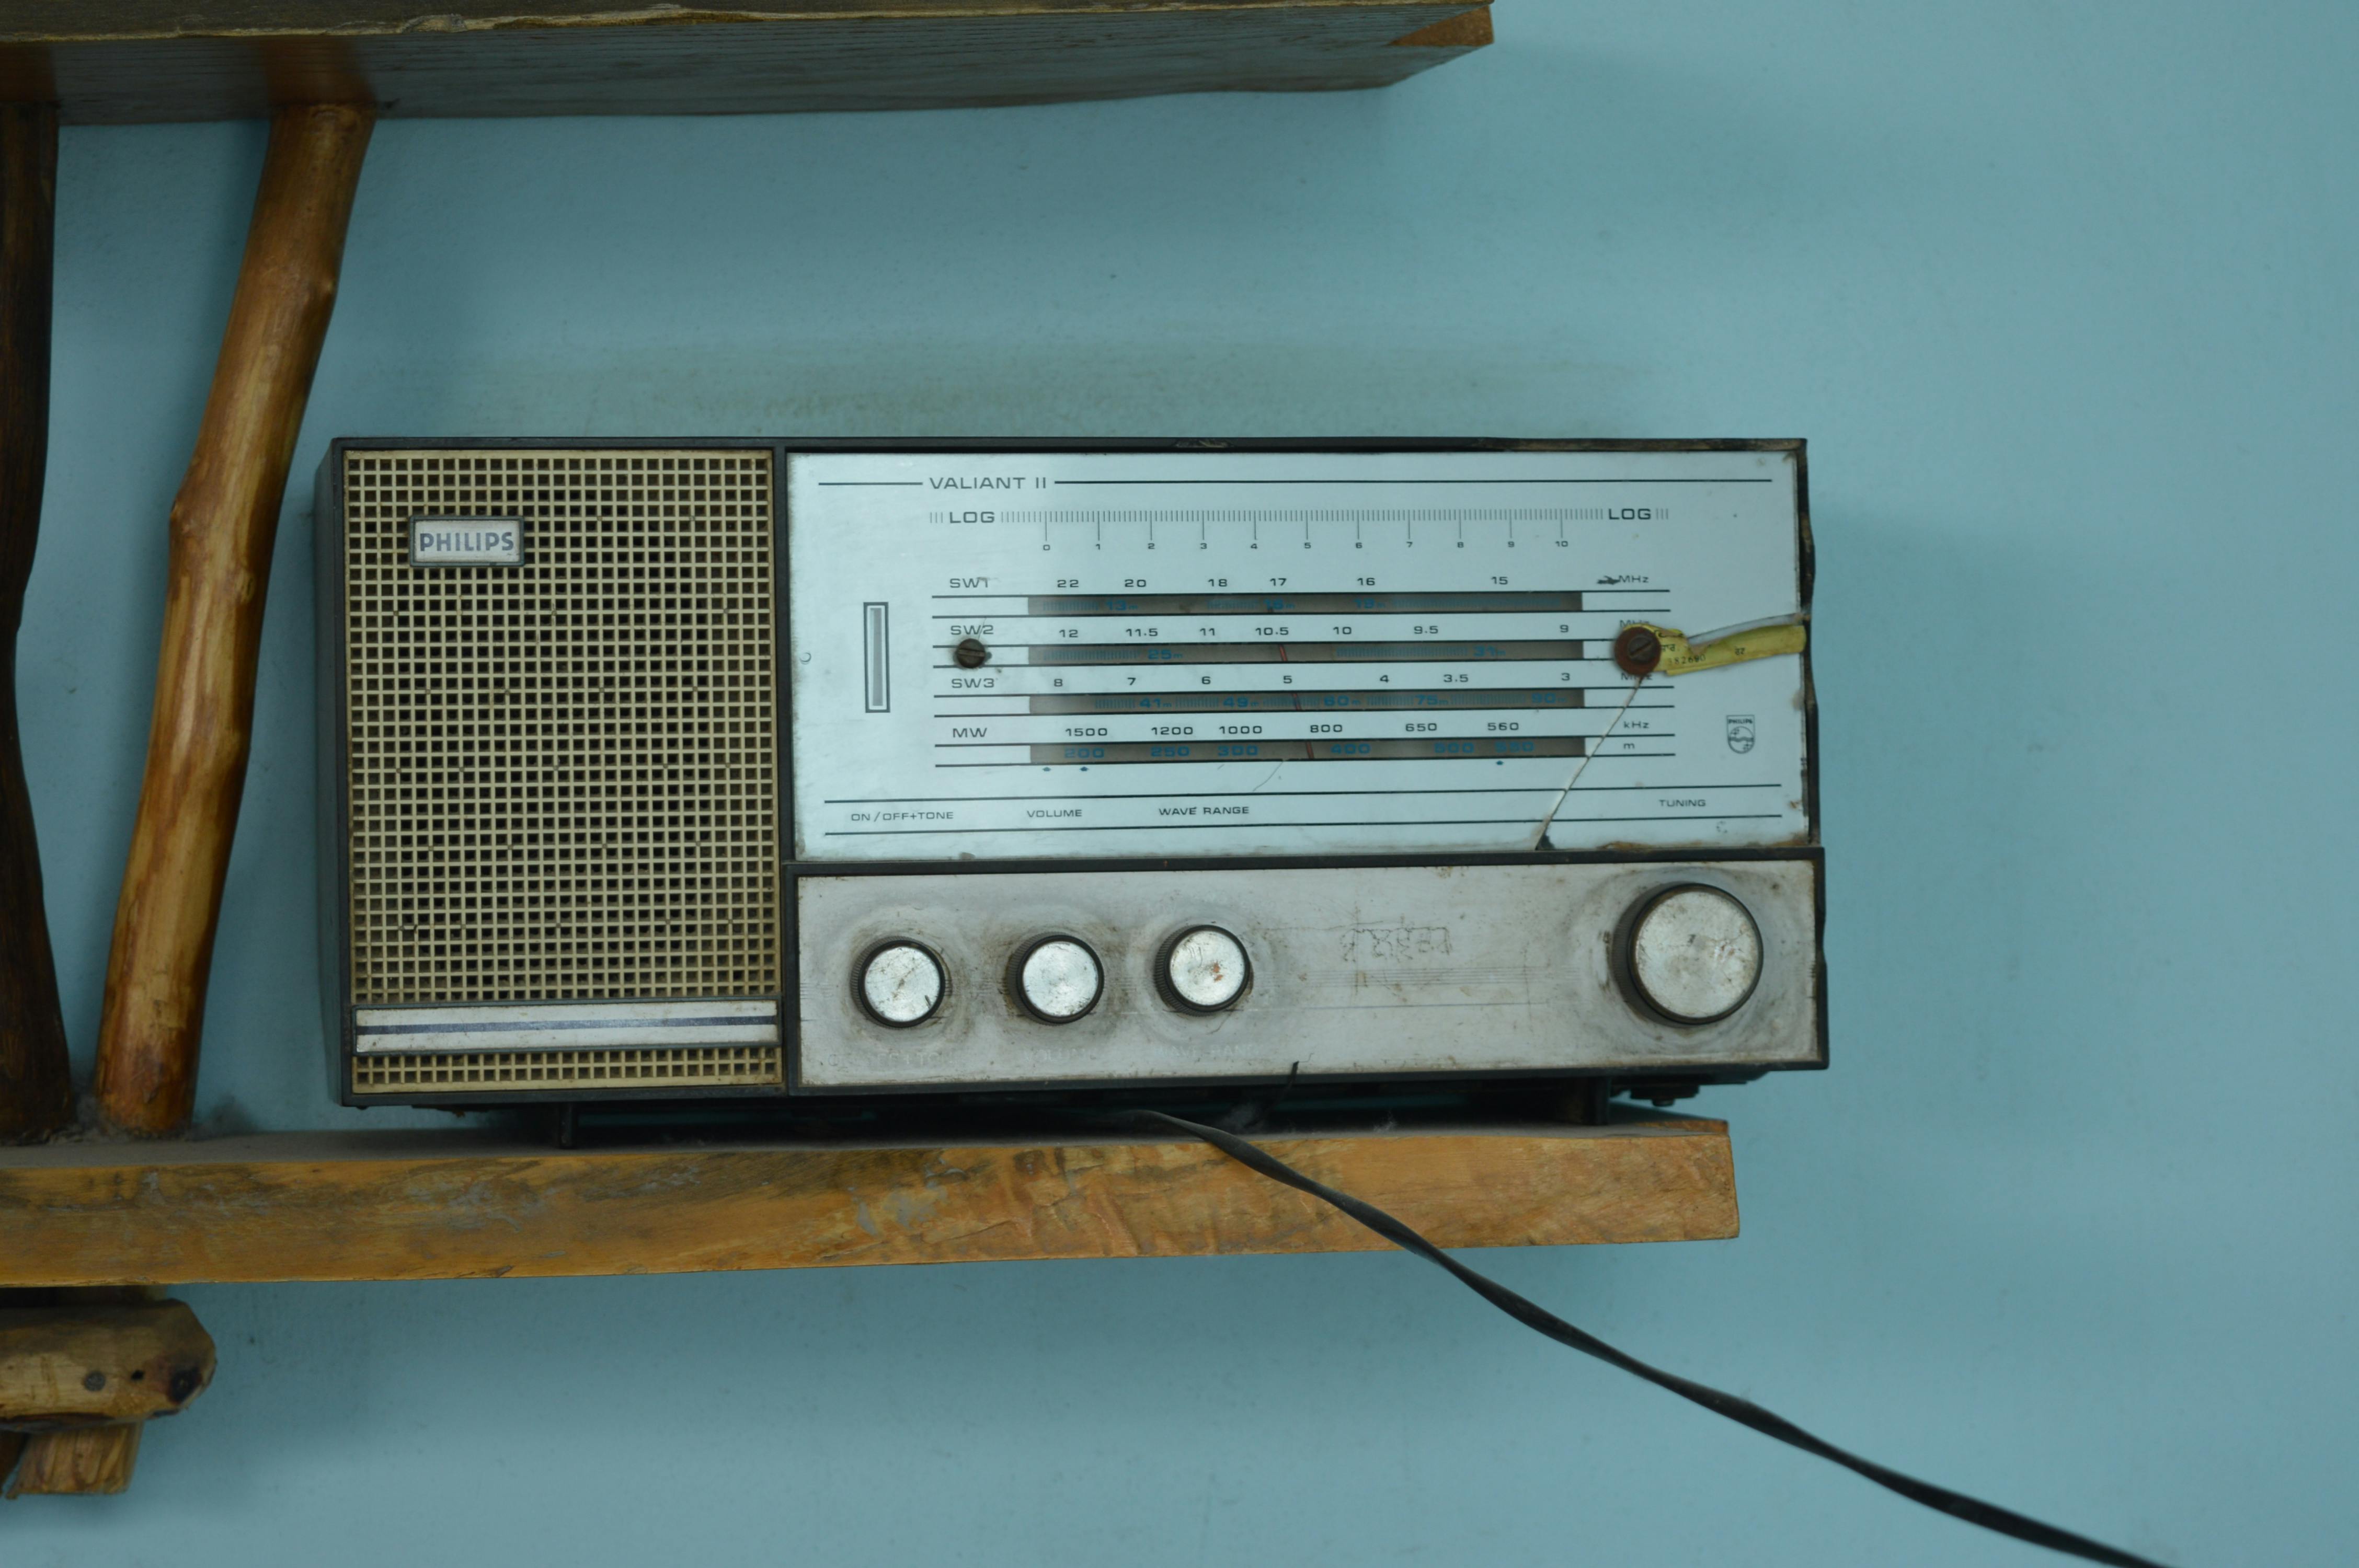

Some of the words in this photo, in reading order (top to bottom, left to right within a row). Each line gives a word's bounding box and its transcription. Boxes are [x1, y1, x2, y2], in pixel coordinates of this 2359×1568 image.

[929, 477, 1026, 489] VALIANT
[1036, 477, 1046, 489] II
[949, 511, 995, 524] LOG
[1608, 508, 1651, 520] LOG
[419, 532, 514, 552] PHILIPS
[949, 577, 988, 589] SW1
[1057, 579, 1079, 588] 22
[1125, 579, 1147, 587] 20
[1208, 579, 1228, 587] 18
[1269, 578, 1287, 586] 17
[1357, 577, 1376, 586] 16
[1491, 576, 1508, 585] 15
[1619, 574, 1650, 583] MHz
[951, 624, 994, 636] SW2
[1059, 629, 1079, 638] 12
[1126, 628, 1158, 637] 11.5
[1199, 628, 1215, 636] 11
[1255, 627, 1289, 636] 10.5
[1333, 626, 1352, 635] 10
[1413, 625, 1439, 635] 9.5
[1560, 624, 1569, 633] 9
[951, 678, 994, 689] SW3
[1053, 678, 1063, 687] 8
[1127, 677, 1137, 686] 7
[1201, 676, 1211, 685] 6
[1283, 675, 1292, 684] 5
[1379, 674, 1389, 683] 4
[1443, 674, 1469, 683] 3.5
[1561, 672, 1571, 682] 3
[1065, 728, 1108, 736] 1500
[1151, 727, 1194, 735] 1200
[1219, 725, 1263, 734] 1000
[1310, 724, 1343, 733] 800
[1405, 722, 1437, 732] 650
[1487, 722, 1519, 731] 560
[1623, 721, 1649, 729] kHz
[953, 728, 988, 738] MW
[1064, 747, 1105, 759] 200
[1151, 745, 1191, 757] 250
[1218, 744, 1259, 757] 300
[1330, 743, 1371, 755] 400
[1659, 799, 1707, 808] TUNING
[1027, 809, 1082, 818] VOLUME
[1159, 806, 1197, 816] WAVE
[1203, 806, 1249, 815] RANGE
